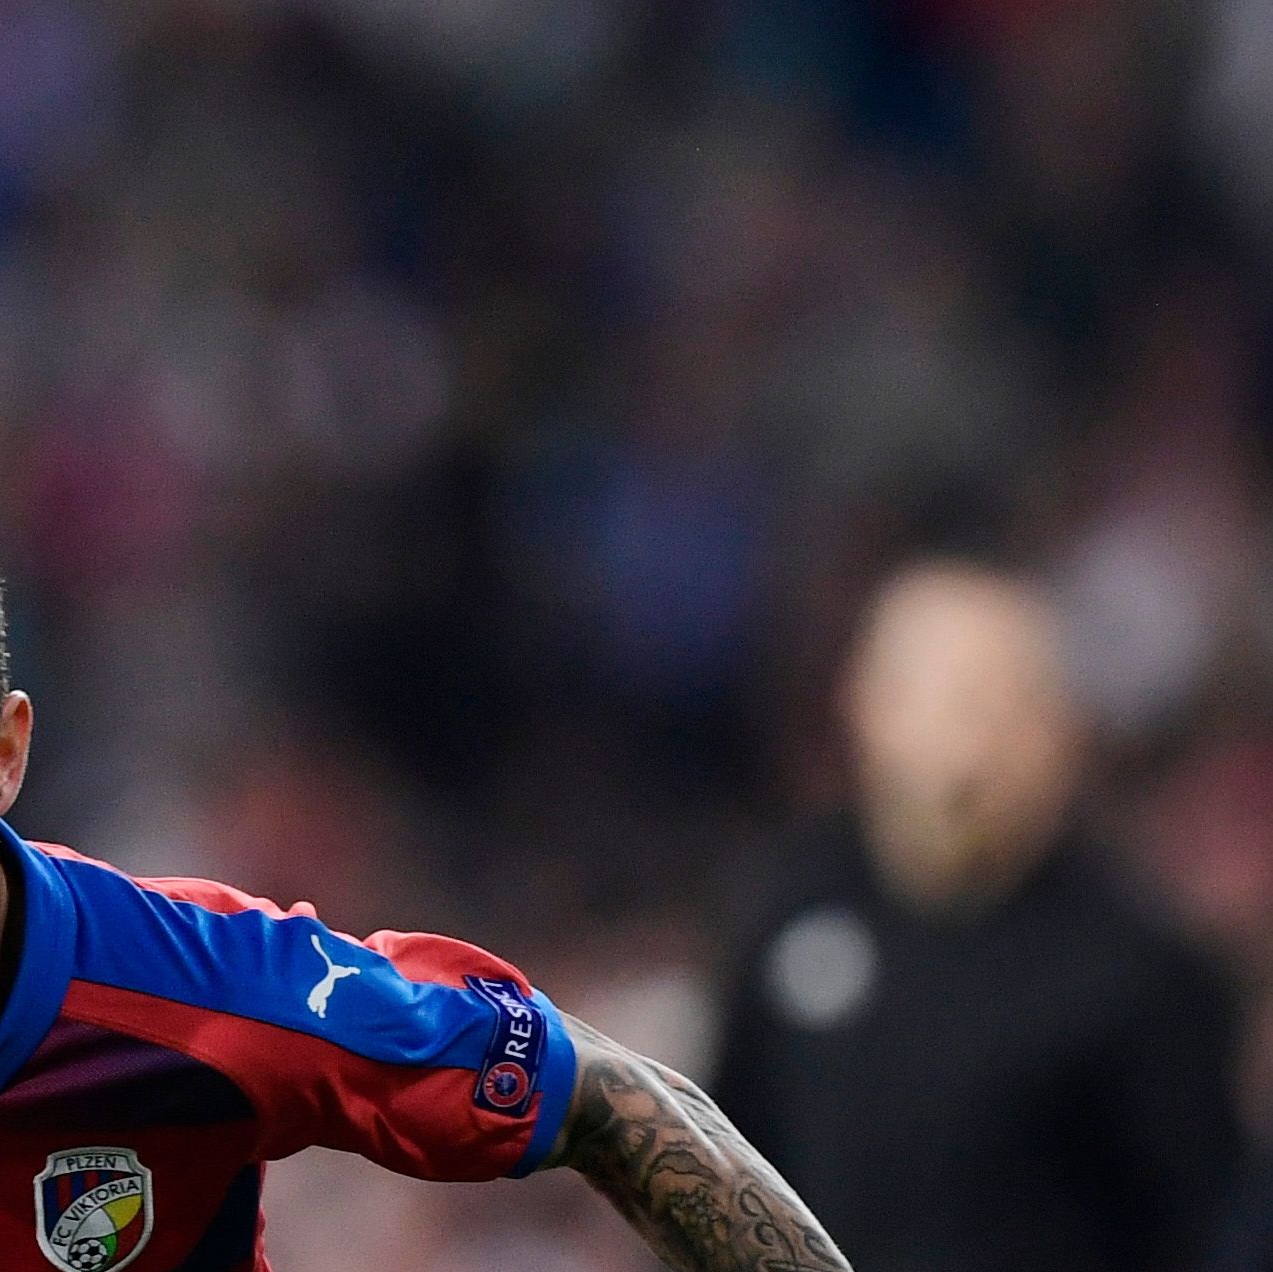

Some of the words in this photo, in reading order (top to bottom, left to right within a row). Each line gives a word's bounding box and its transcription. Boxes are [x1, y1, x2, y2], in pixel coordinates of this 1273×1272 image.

[478, 977, 533, 1059] RESPCT
[52, 1226, 71, 1247] FC
[65, 1179, 139, 1222] VIKTORIA
